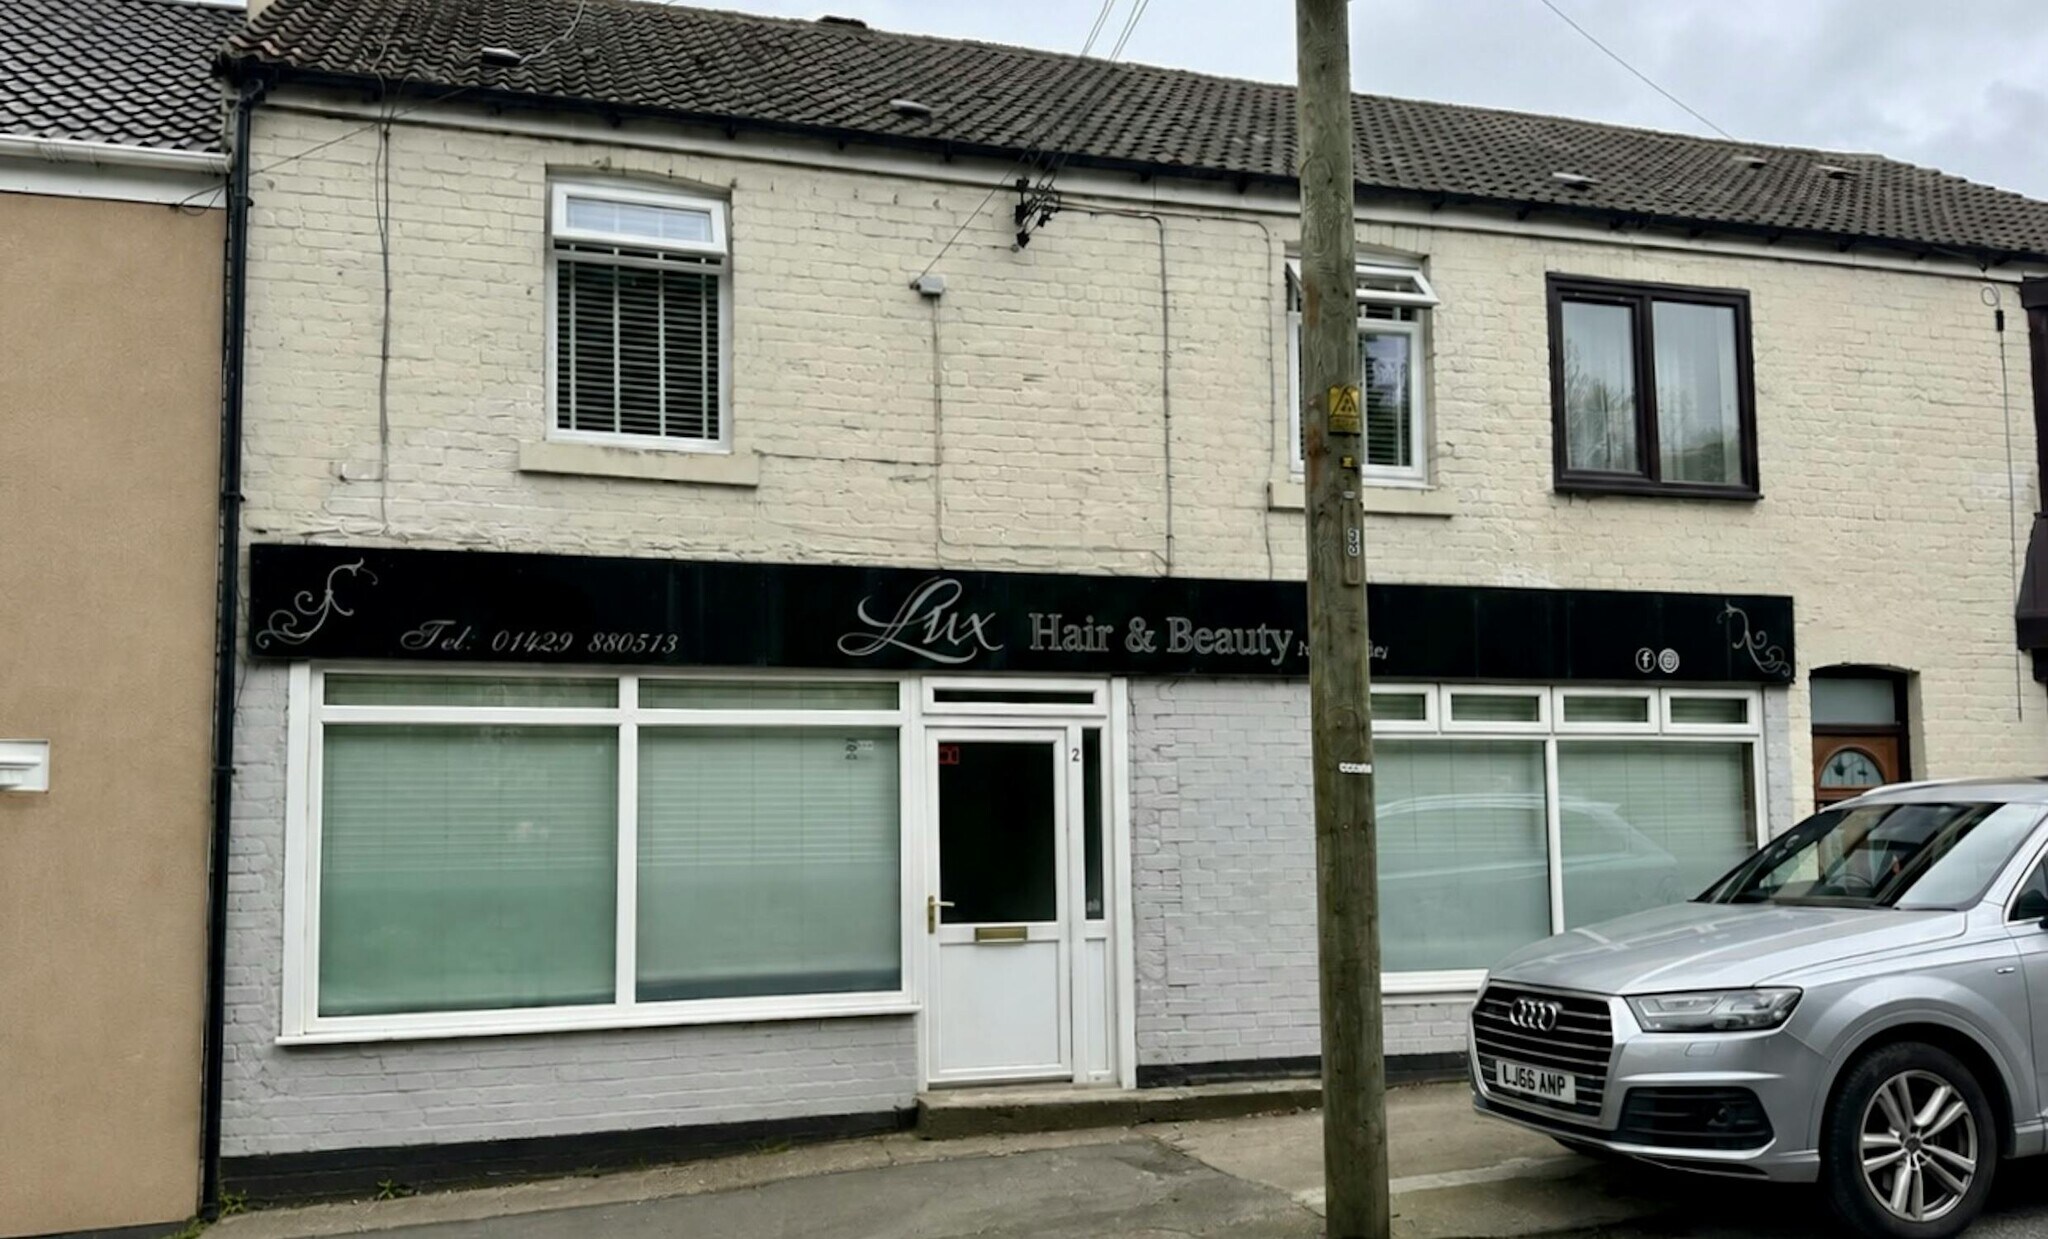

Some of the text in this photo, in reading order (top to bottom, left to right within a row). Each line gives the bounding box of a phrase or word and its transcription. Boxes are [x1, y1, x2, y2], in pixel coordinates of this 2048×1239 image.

[837, 576, 1294, 666] Lux Hair & Beauty
[400, 620, 679, 654] Tel: 01429 880513
[1071, 747, 1081, 762] 2
[1503, 1064, 1536, 1090] LJ66
